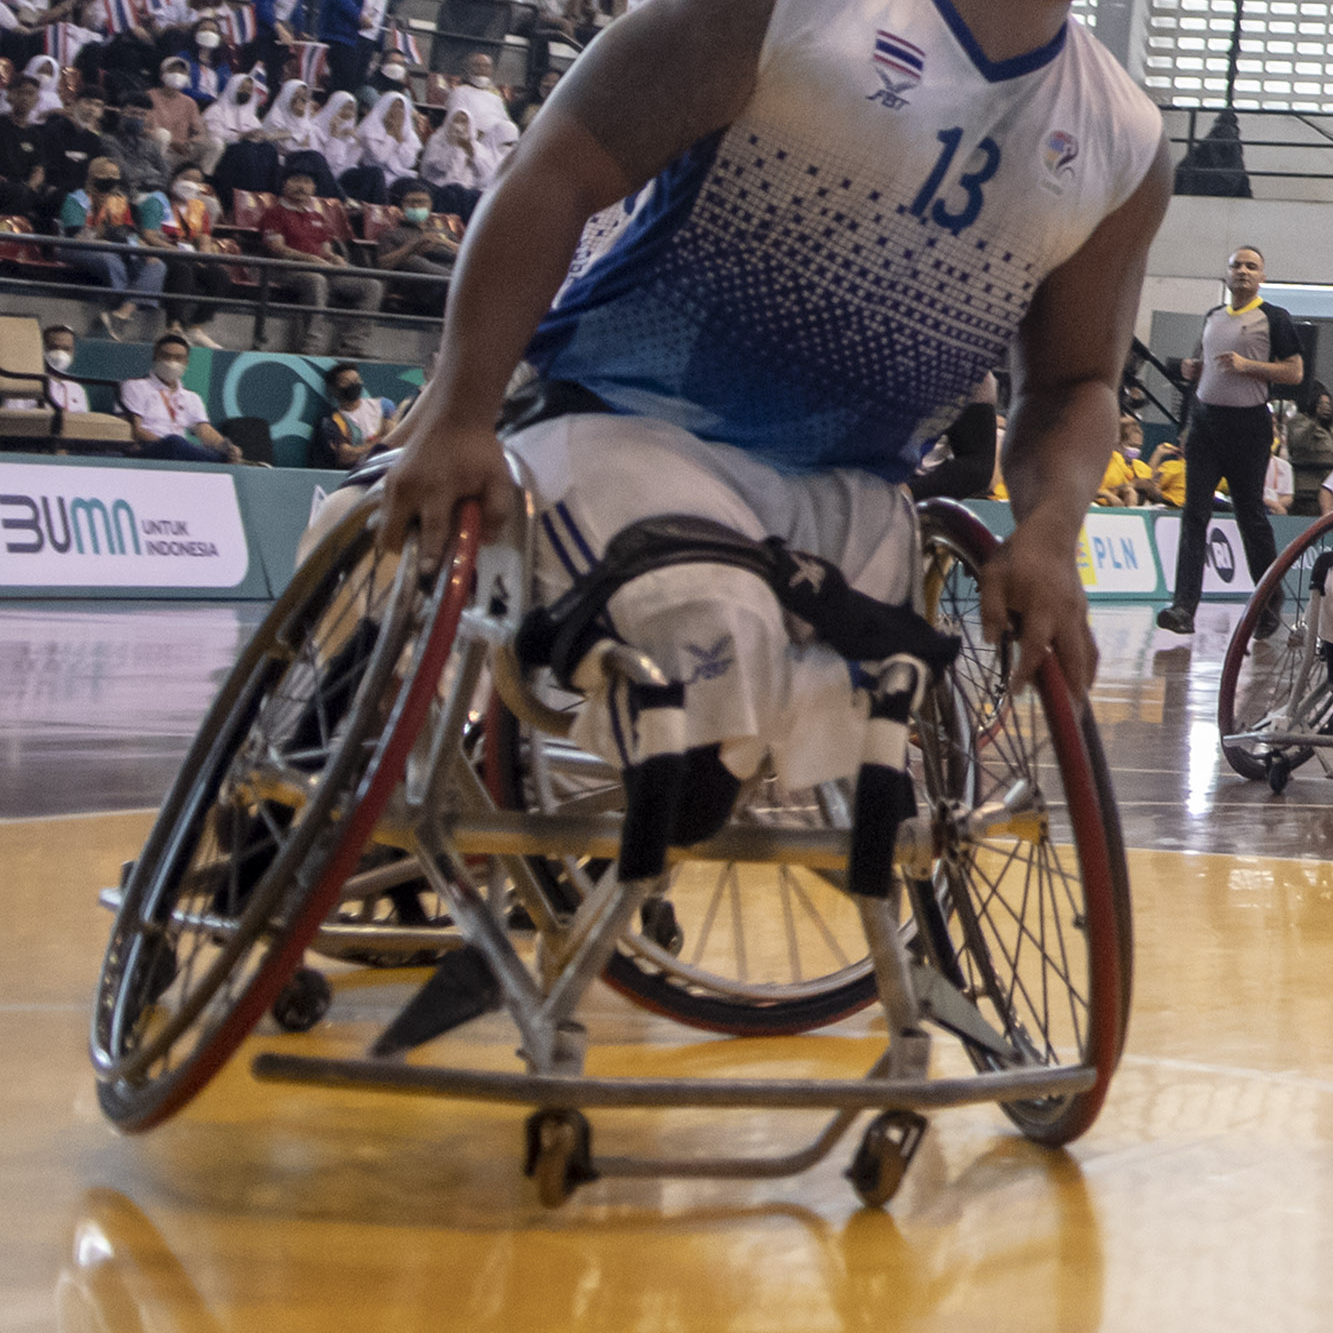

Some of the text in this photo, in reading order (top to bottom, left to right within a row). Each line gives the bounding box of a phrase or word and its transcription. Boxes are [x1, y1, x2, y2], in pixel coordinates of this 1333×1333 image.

[908, 127, 1001, 231] 13
[141, 519, 190, 537] UNTUK
[145, 539, 219, 557] INDONESIA
[1094, 537, 1139, 570] PLN
